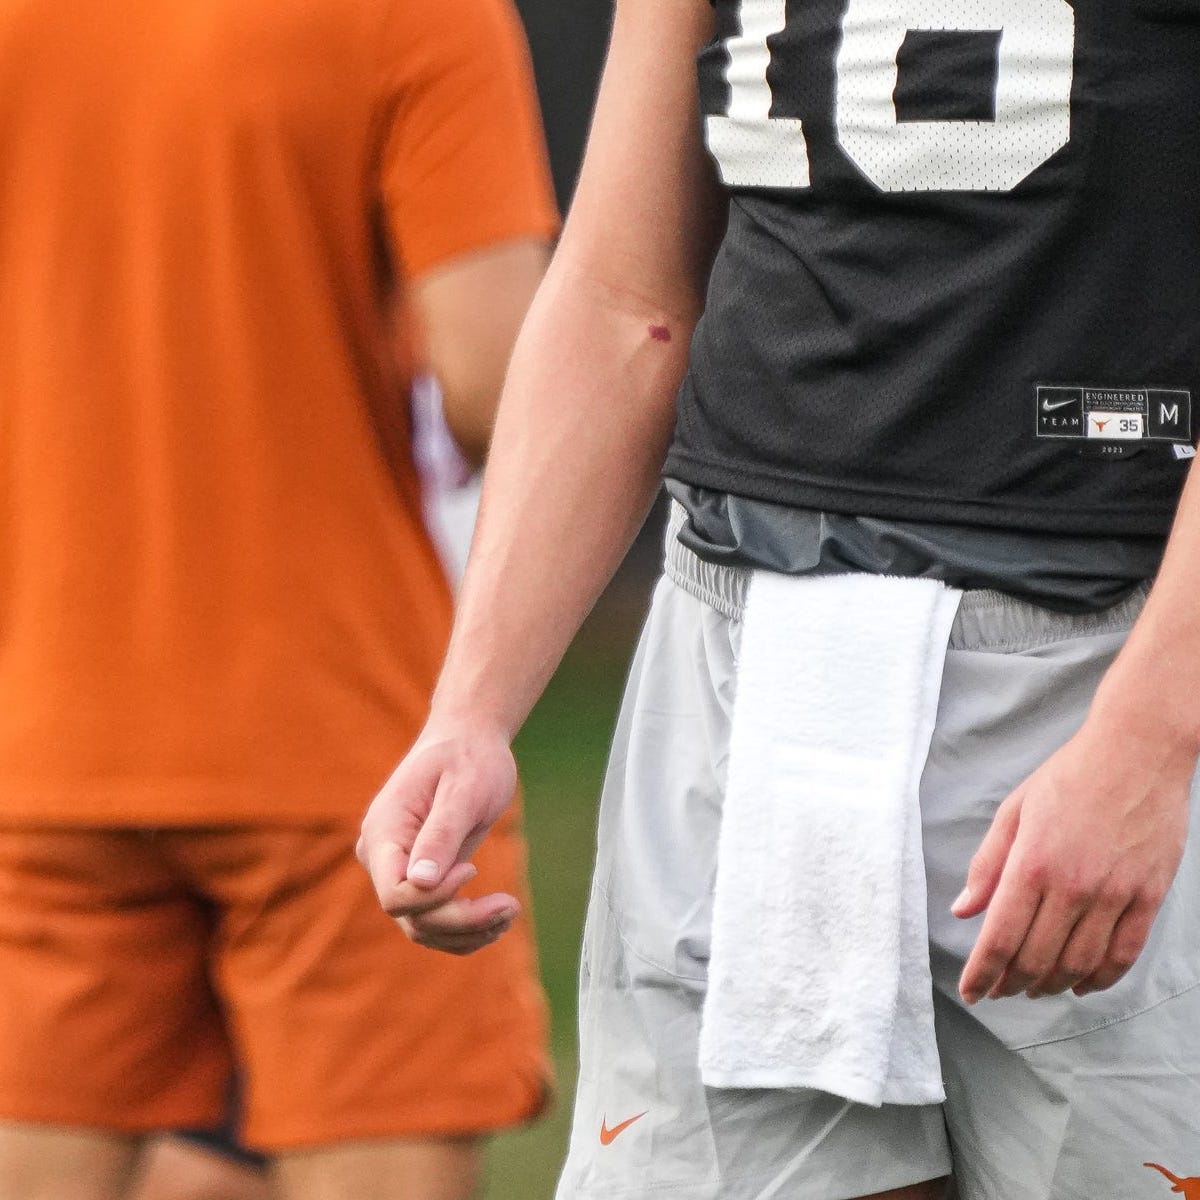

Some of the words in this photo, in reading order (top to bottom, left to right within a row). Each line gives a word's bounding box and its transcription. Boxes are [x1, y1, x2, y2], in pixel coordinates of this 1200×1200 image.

[1086, 392, 1144, 401] ENGINEERED
[1160, 403, 1179, 425] M
[1042, 417, 1079, 426] TEAM
[1119, 419, 1138, 432] 35
